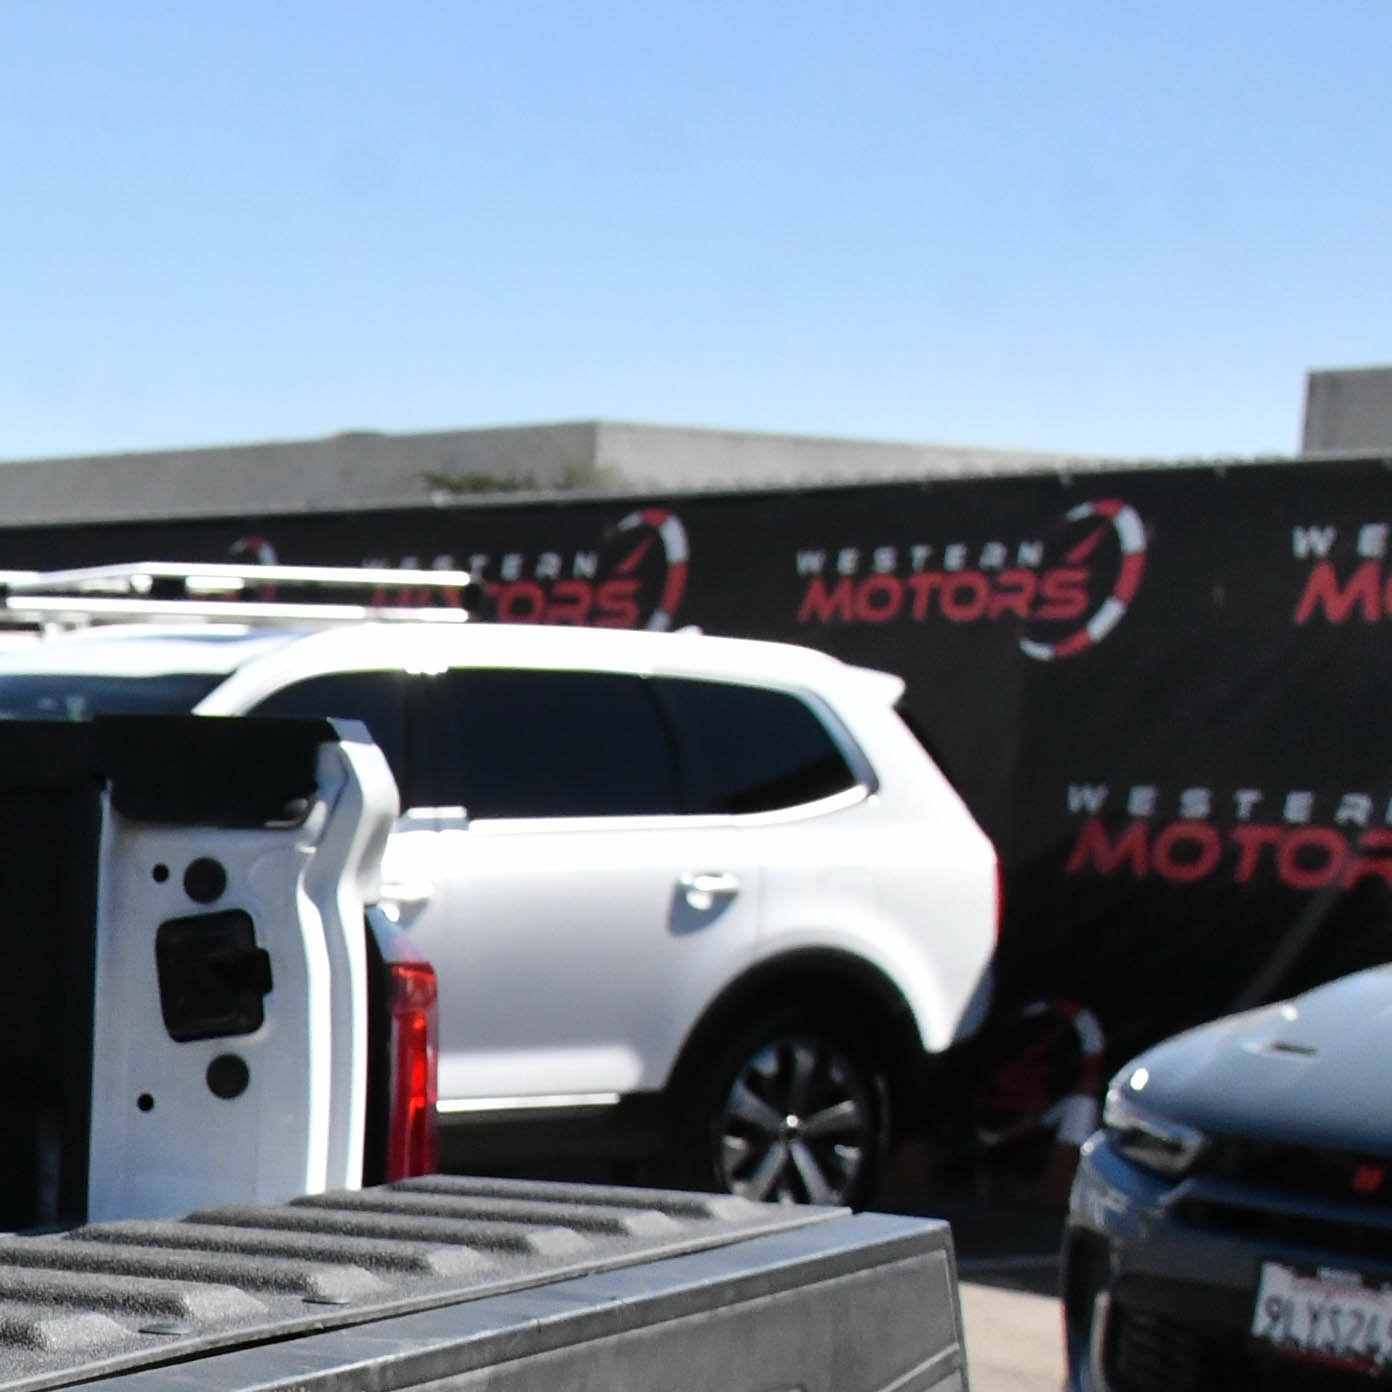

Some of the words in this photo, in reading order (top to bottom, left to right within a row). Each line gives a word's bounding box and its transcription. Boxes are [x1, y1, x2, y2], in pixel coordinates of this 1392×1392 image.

[796, 541, 1043, 574] WESTERN
[797, 568, 1090, 622] MOTORS
[1295, 561, 1392, 623] M
[1067, 784, 1392, 826] WESTER
